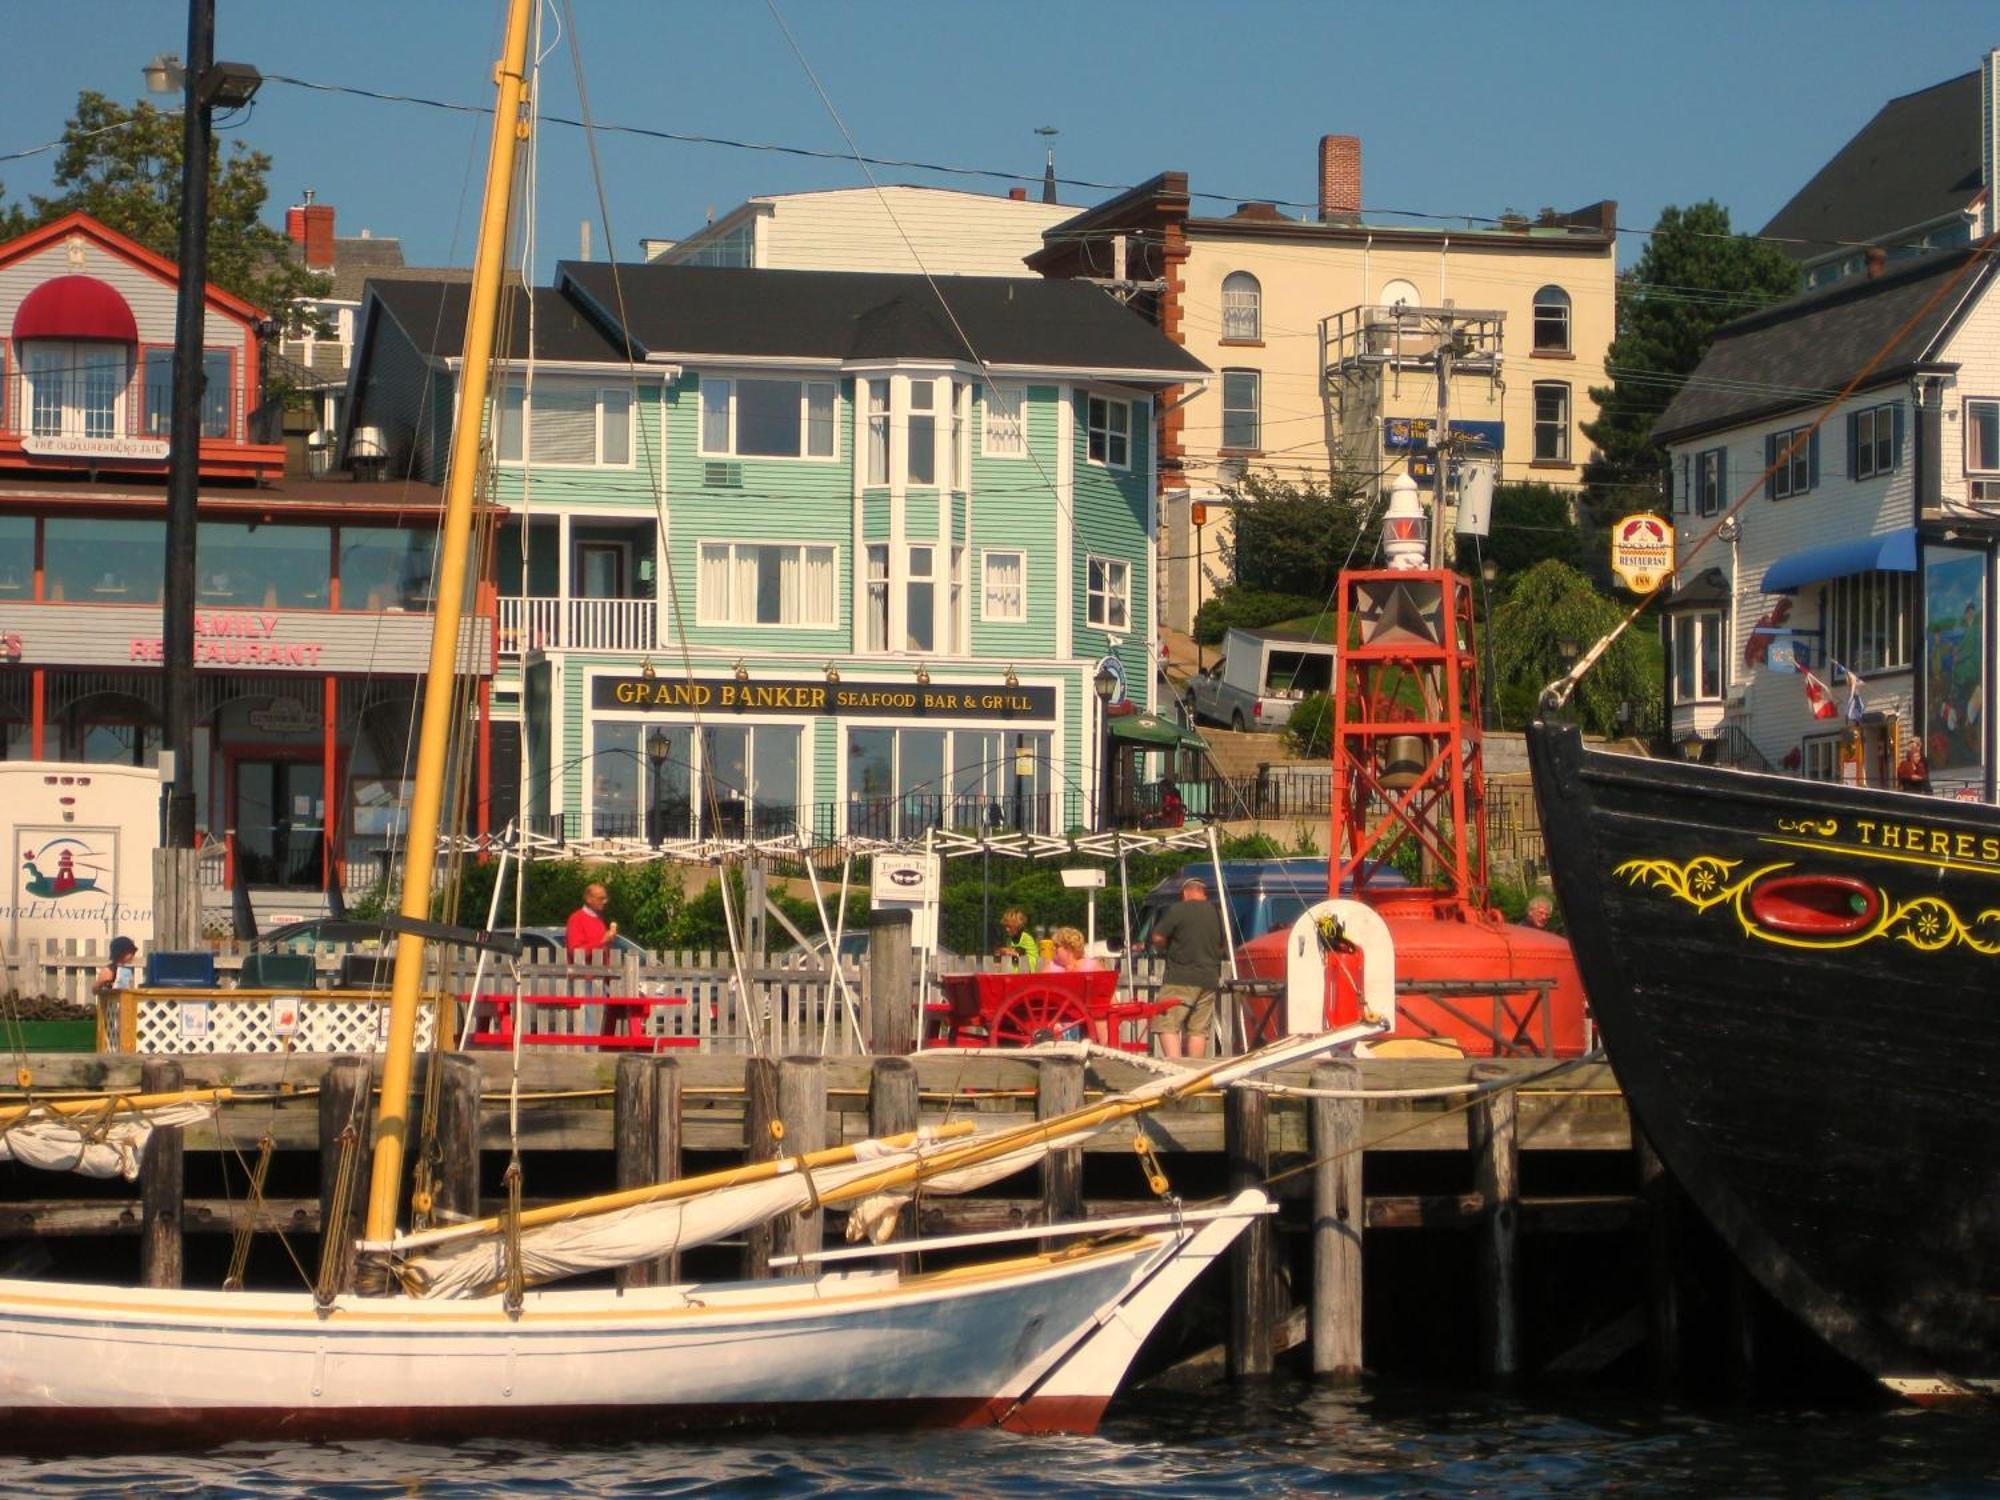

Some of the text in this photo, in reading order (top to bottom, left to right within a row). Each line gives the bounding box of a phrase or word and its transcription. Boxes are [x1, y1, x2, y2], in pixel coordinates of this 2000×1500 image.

[1619, 556, 1666, 566] RESTAURANT
[194, 615, 280, 637] AMILY
[130, 640, 322, 666] RETAURANT
[616, 683, 1032, 710] GRAND BANKER SEAFOOD BAR & GRILL
[1857, 821, 2000, 861] THERES
